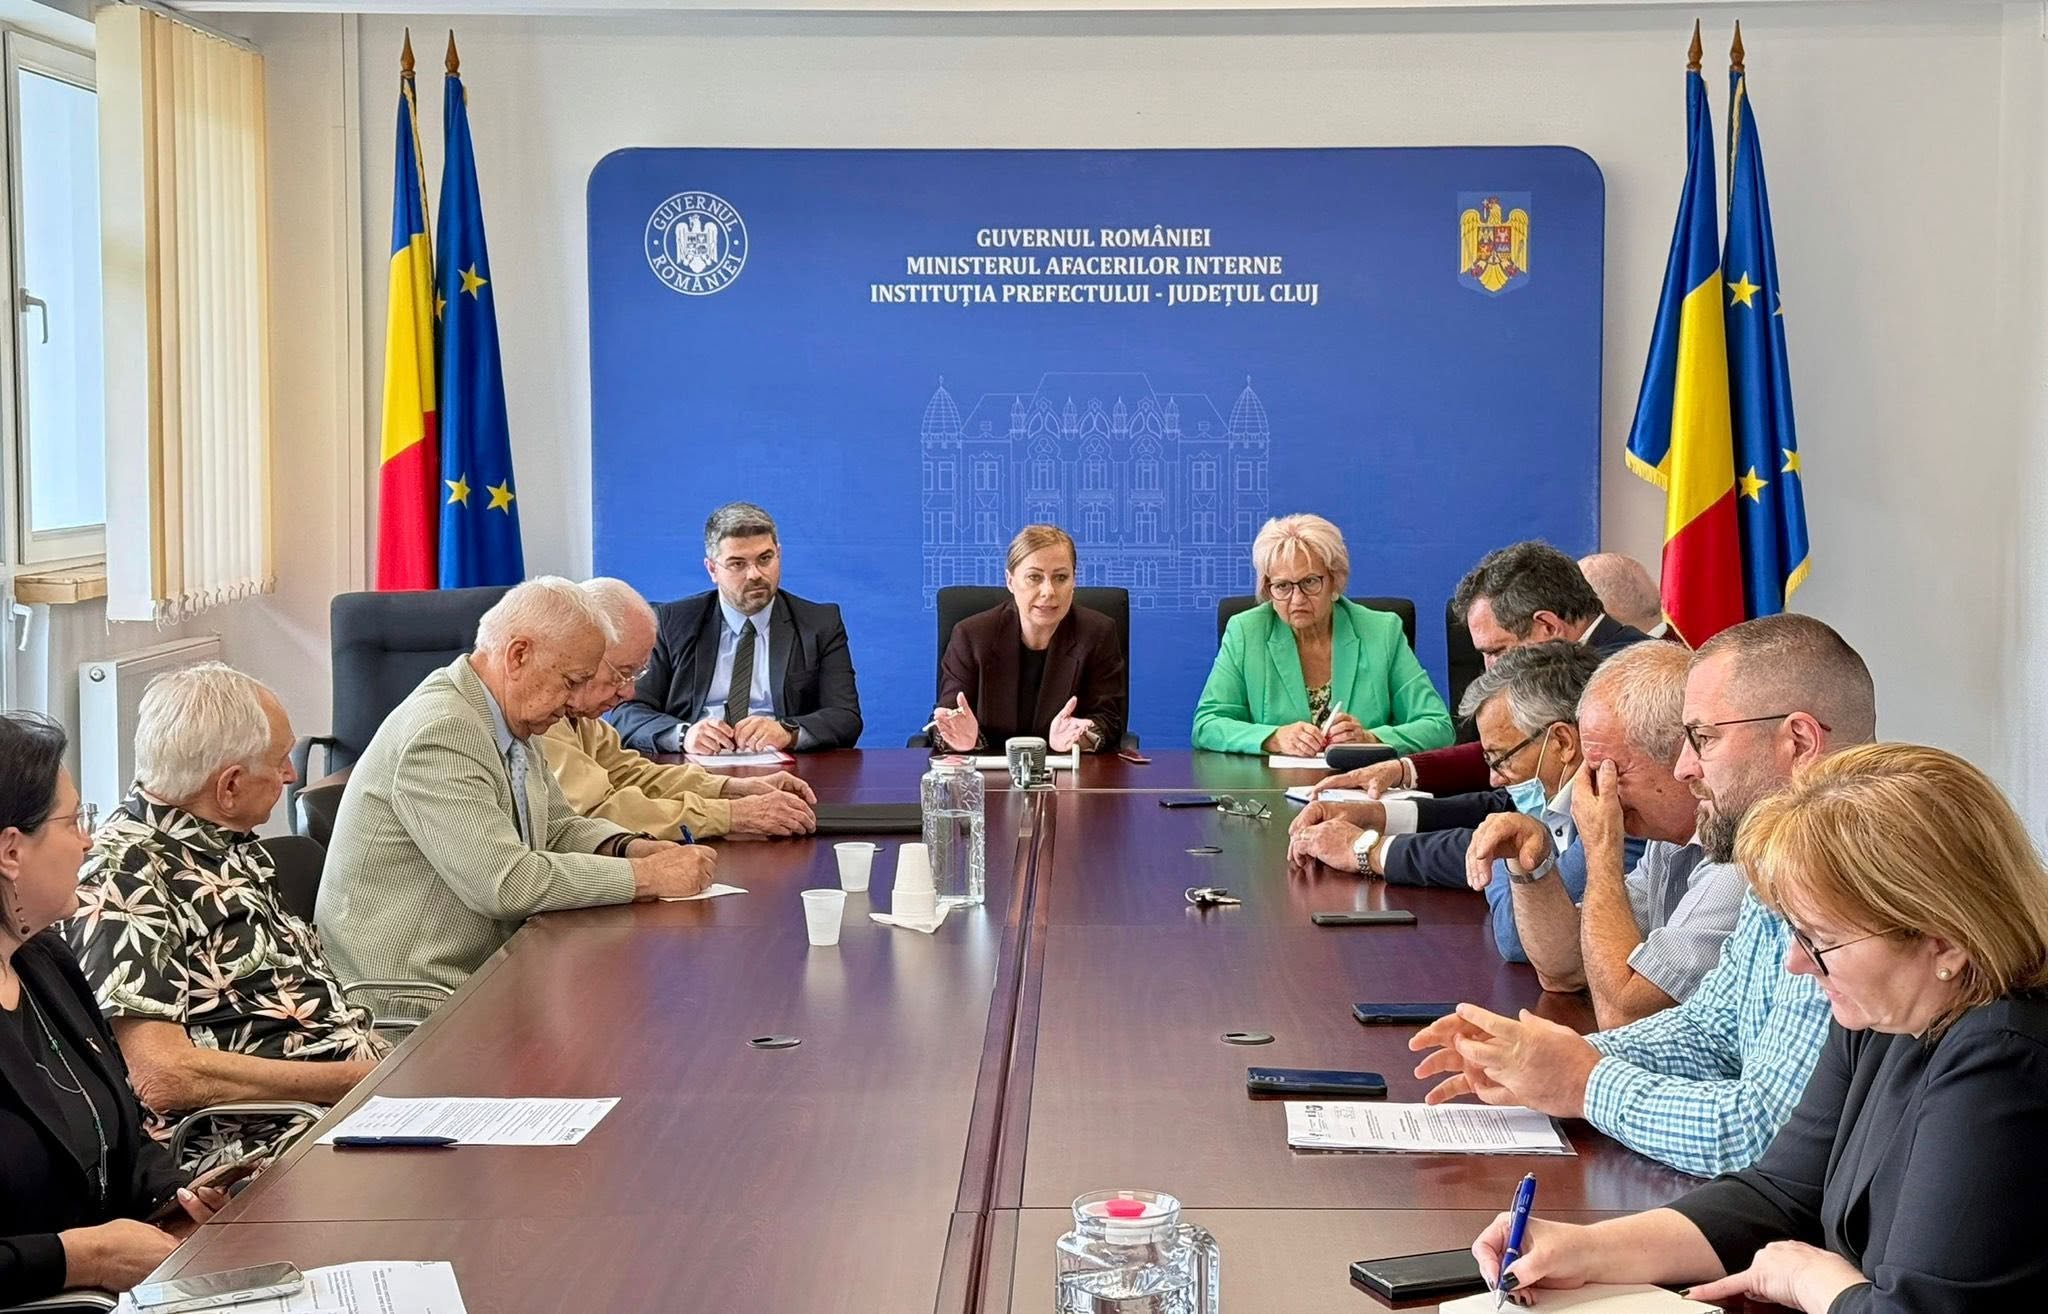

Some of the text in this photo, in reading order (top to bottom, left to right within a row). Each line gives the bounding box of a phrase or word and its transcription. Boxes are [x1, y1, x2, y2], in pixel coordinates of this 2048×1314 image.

[652, 195, 739, 232] GUVERNUL
[976, 225, 1211, 247] GUVERNUL ROMÂNIEI
[906, 256, 1282, 275] MINISTERUL AFACERILOR INTERNE
[1001, 284, 1150, 303] PREFECTULUI
[1269, 284, 1319, 306] CLUJ
